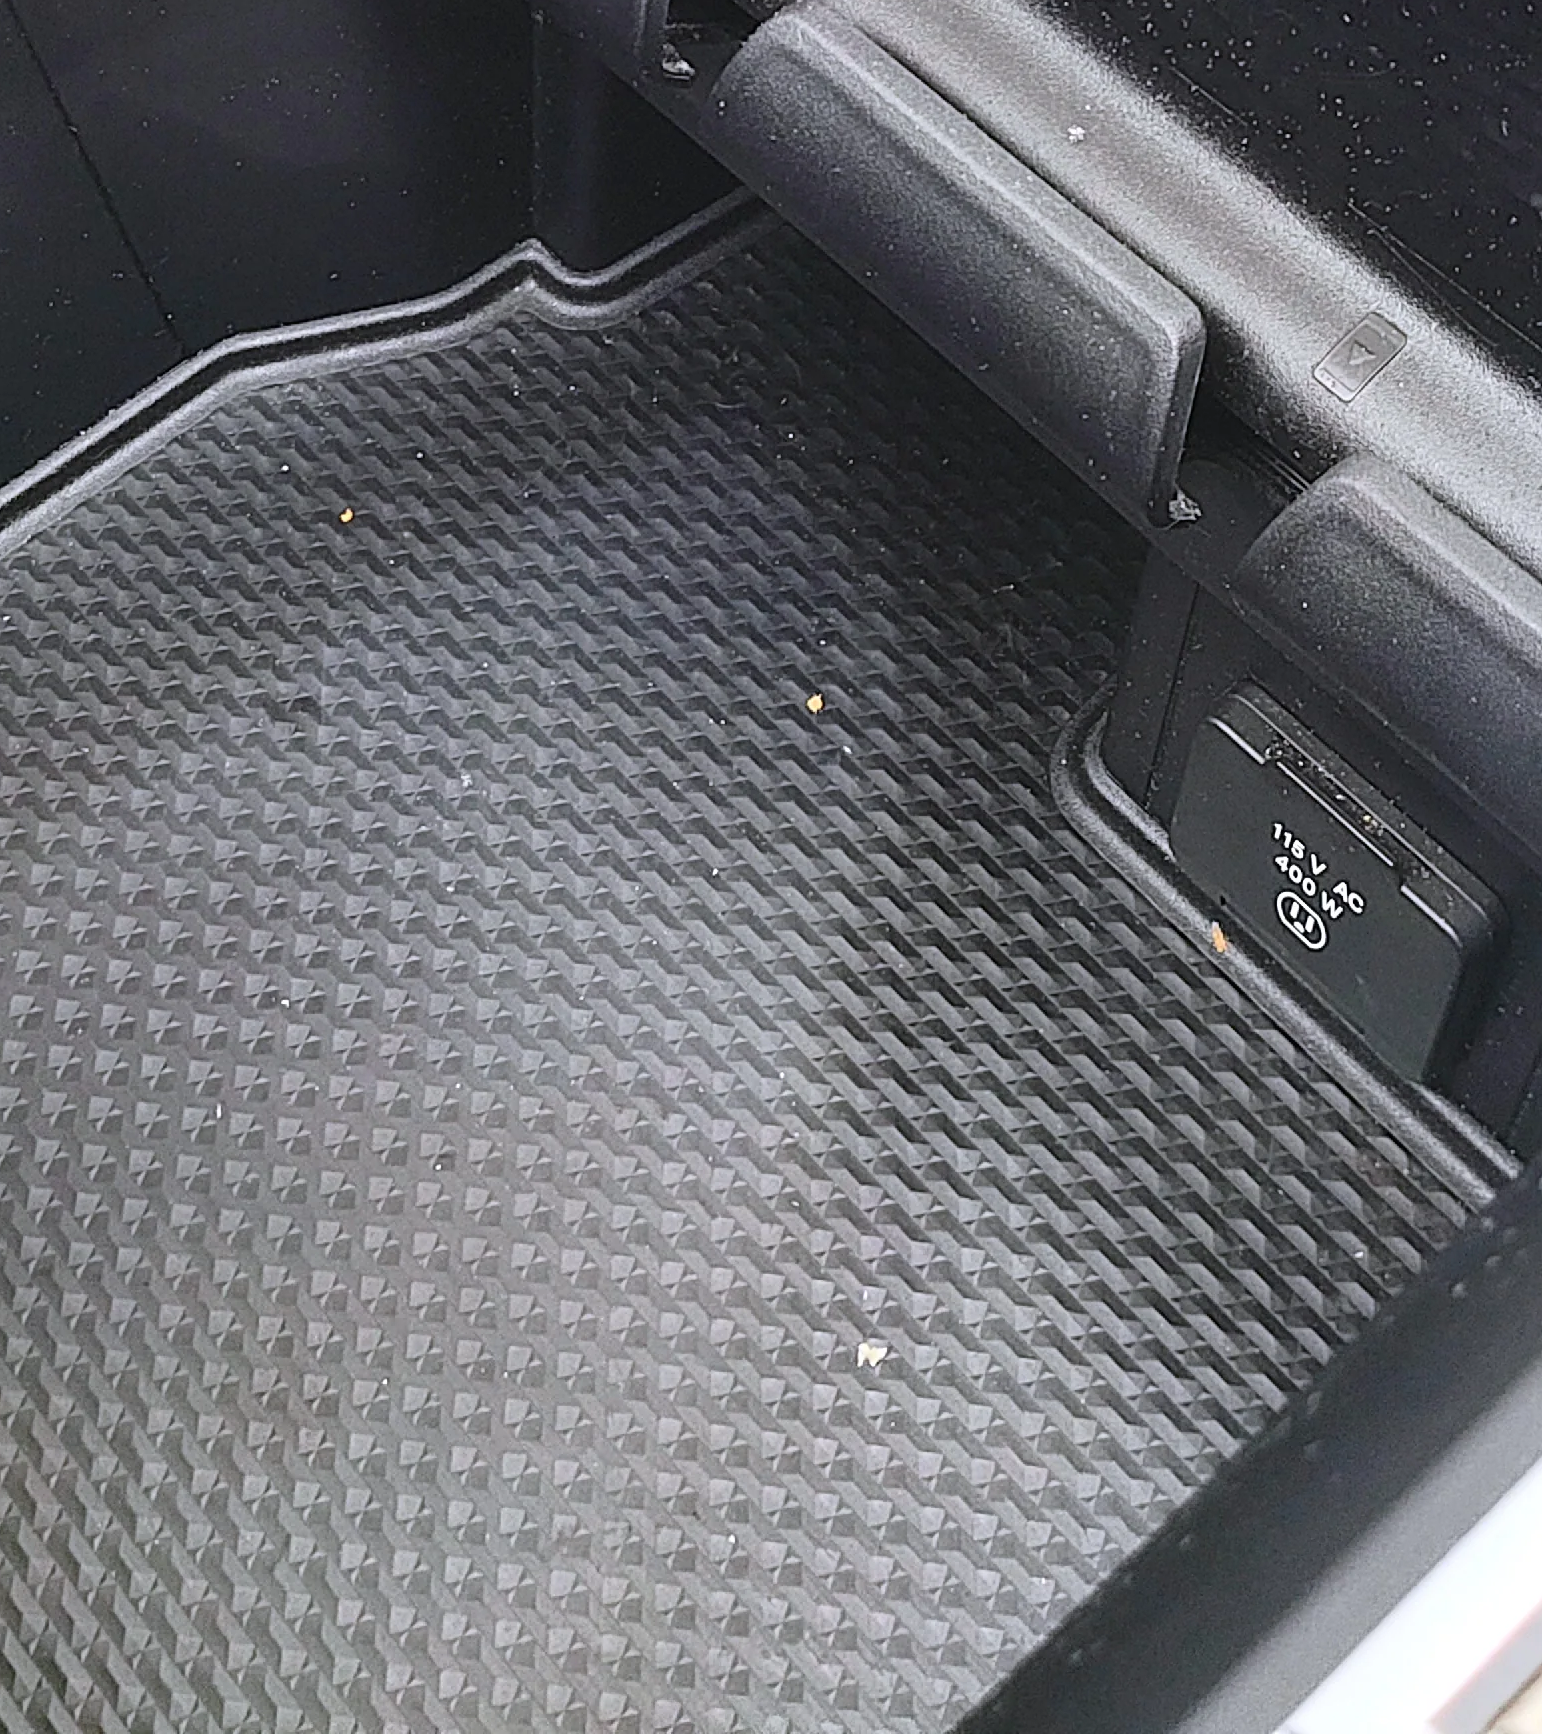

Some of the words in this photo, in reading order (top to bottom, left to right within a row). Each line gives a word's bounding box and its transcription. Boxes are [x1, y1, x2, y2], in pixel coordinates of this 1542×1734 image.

[1273, 823, 1306, 859] 115
[1310, 854, 1326, 875] V
[1332, 881, 1365, 914] AC
[1274, 855, 1316, 897] 400
[1321, 891, 1343, 918] W
